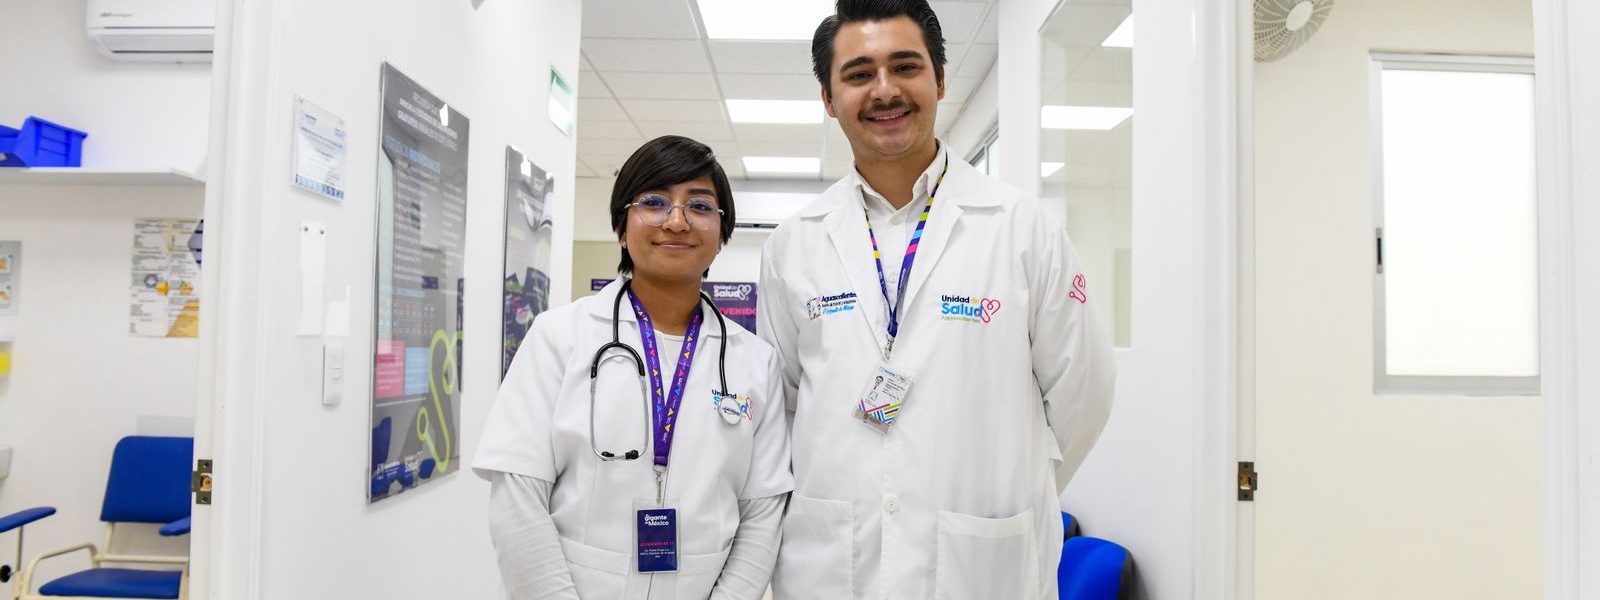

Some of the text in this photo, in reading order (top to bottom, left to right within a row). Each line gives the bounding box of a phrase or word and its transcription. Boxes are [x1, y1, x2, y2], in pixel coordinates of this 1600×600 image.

[713, 289, 740, 298] Salud
[941, 294, 970, 303] Unidad
[941, 302, 982, 317] Salud
